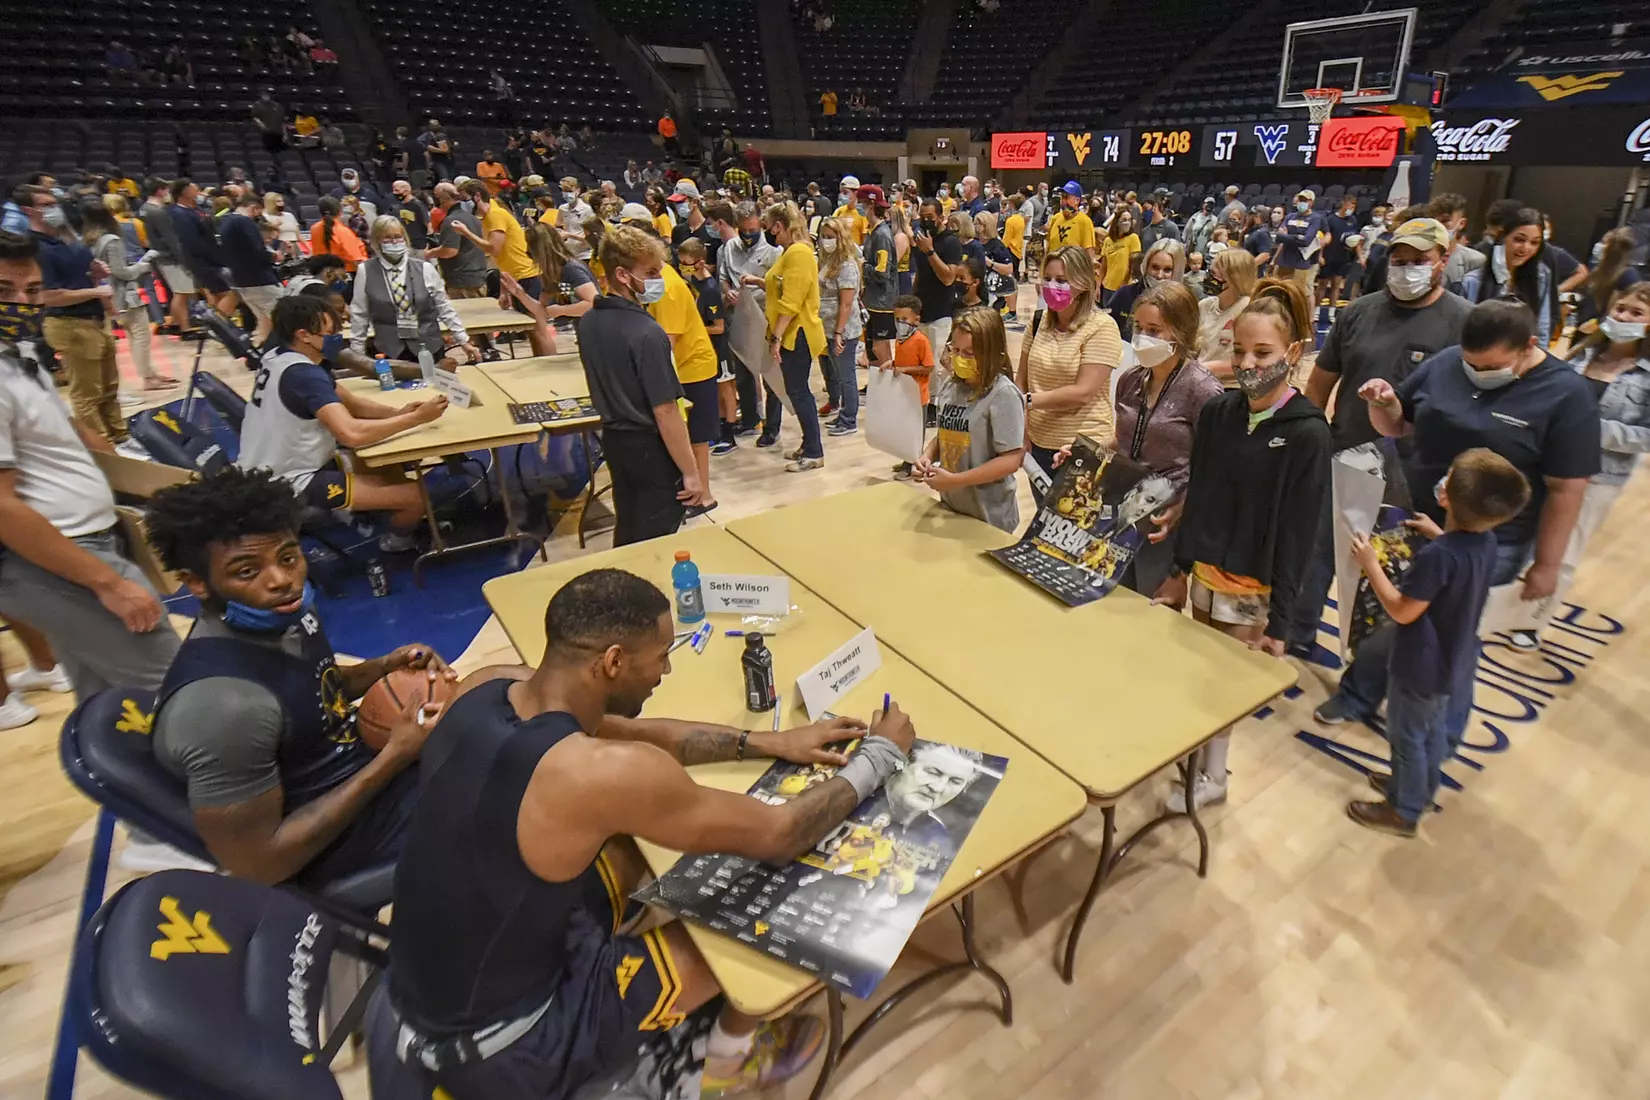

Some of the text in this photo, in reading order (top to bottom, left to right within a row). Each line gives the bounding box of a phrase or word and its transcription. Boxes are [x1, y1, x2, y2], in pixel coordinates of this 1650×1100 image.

[1139, 130, 1191, 155] 27:08
[1307, 131, 1316, 144] 3
[1103, 135, 1120, 162] 74
[1213, 131, 1237, 161] 57
[1303, 151, 1312, 165] 2
[1457, 153, 1491, 161] SUGAR
[942, 403, 967, 418] WEST
[709, 581, 770, 593] Seth Wilson
[818, 668, 833, 681] Taj
[831, 645, 861, 671] Thweatt
